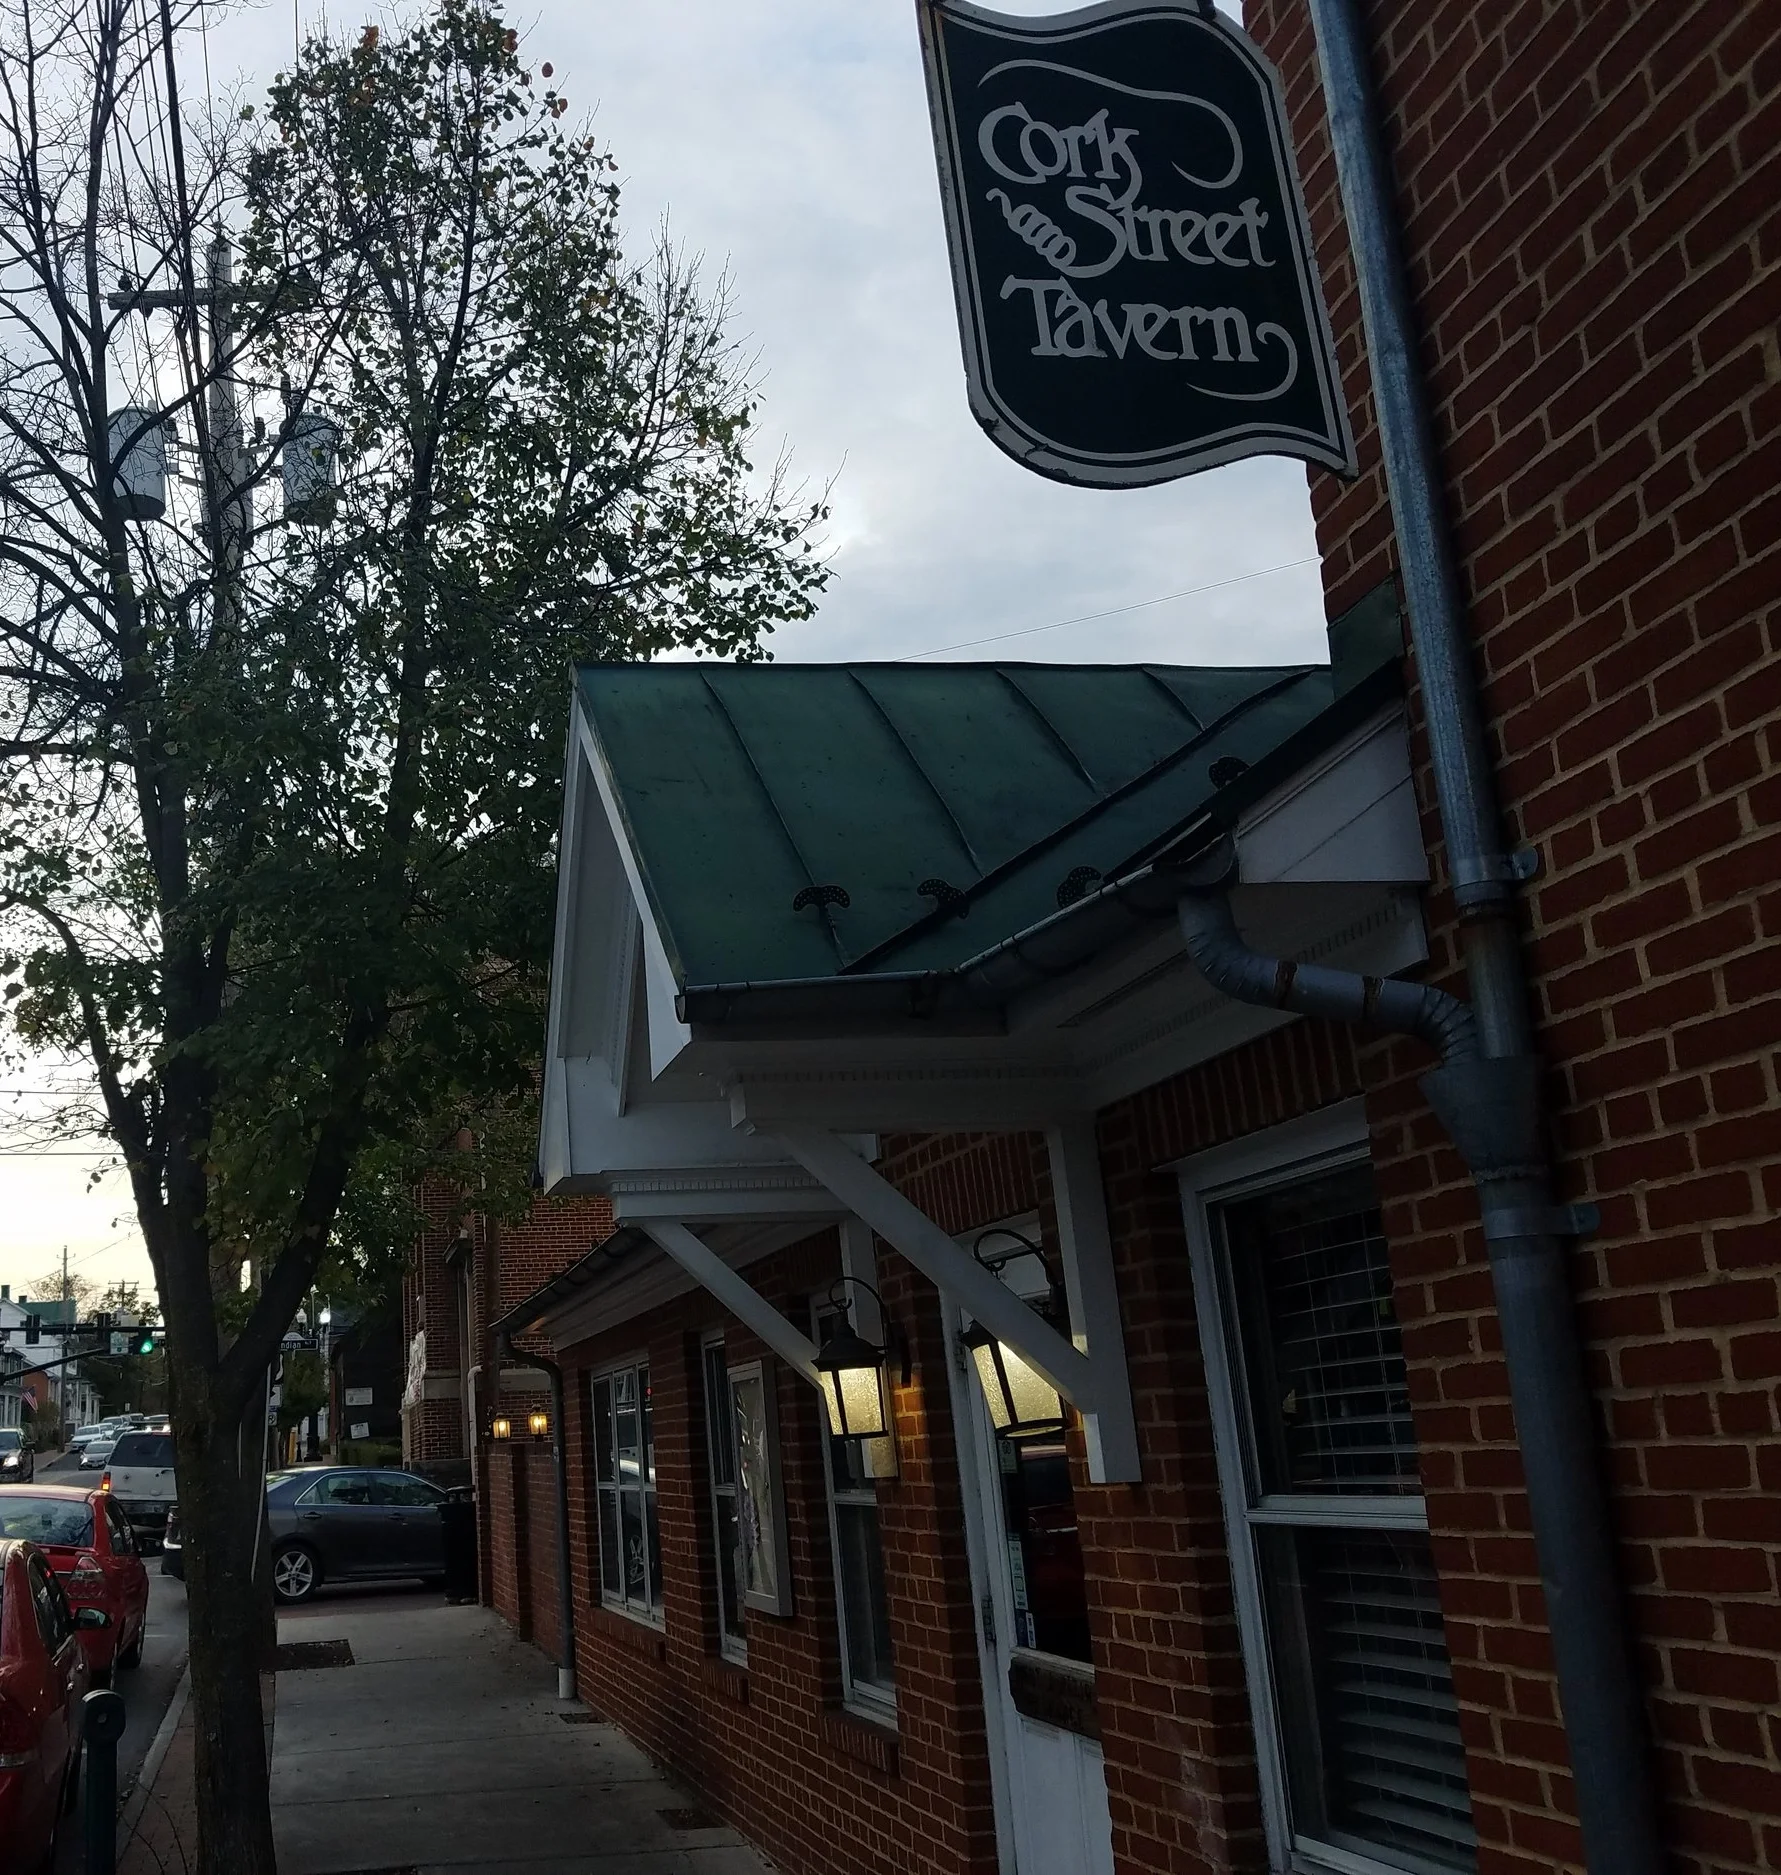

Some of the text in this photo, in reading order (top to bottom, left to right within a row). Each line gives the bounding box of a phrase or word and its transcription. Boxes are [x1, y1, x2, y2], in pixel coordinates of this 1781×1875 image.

[978, 101, 1142, 200] Cork
[1055, 183, 1276, 278] Street
[1000, 274, 1260, 362] Tavern
[280, 1341, 302, 1349] ndian
